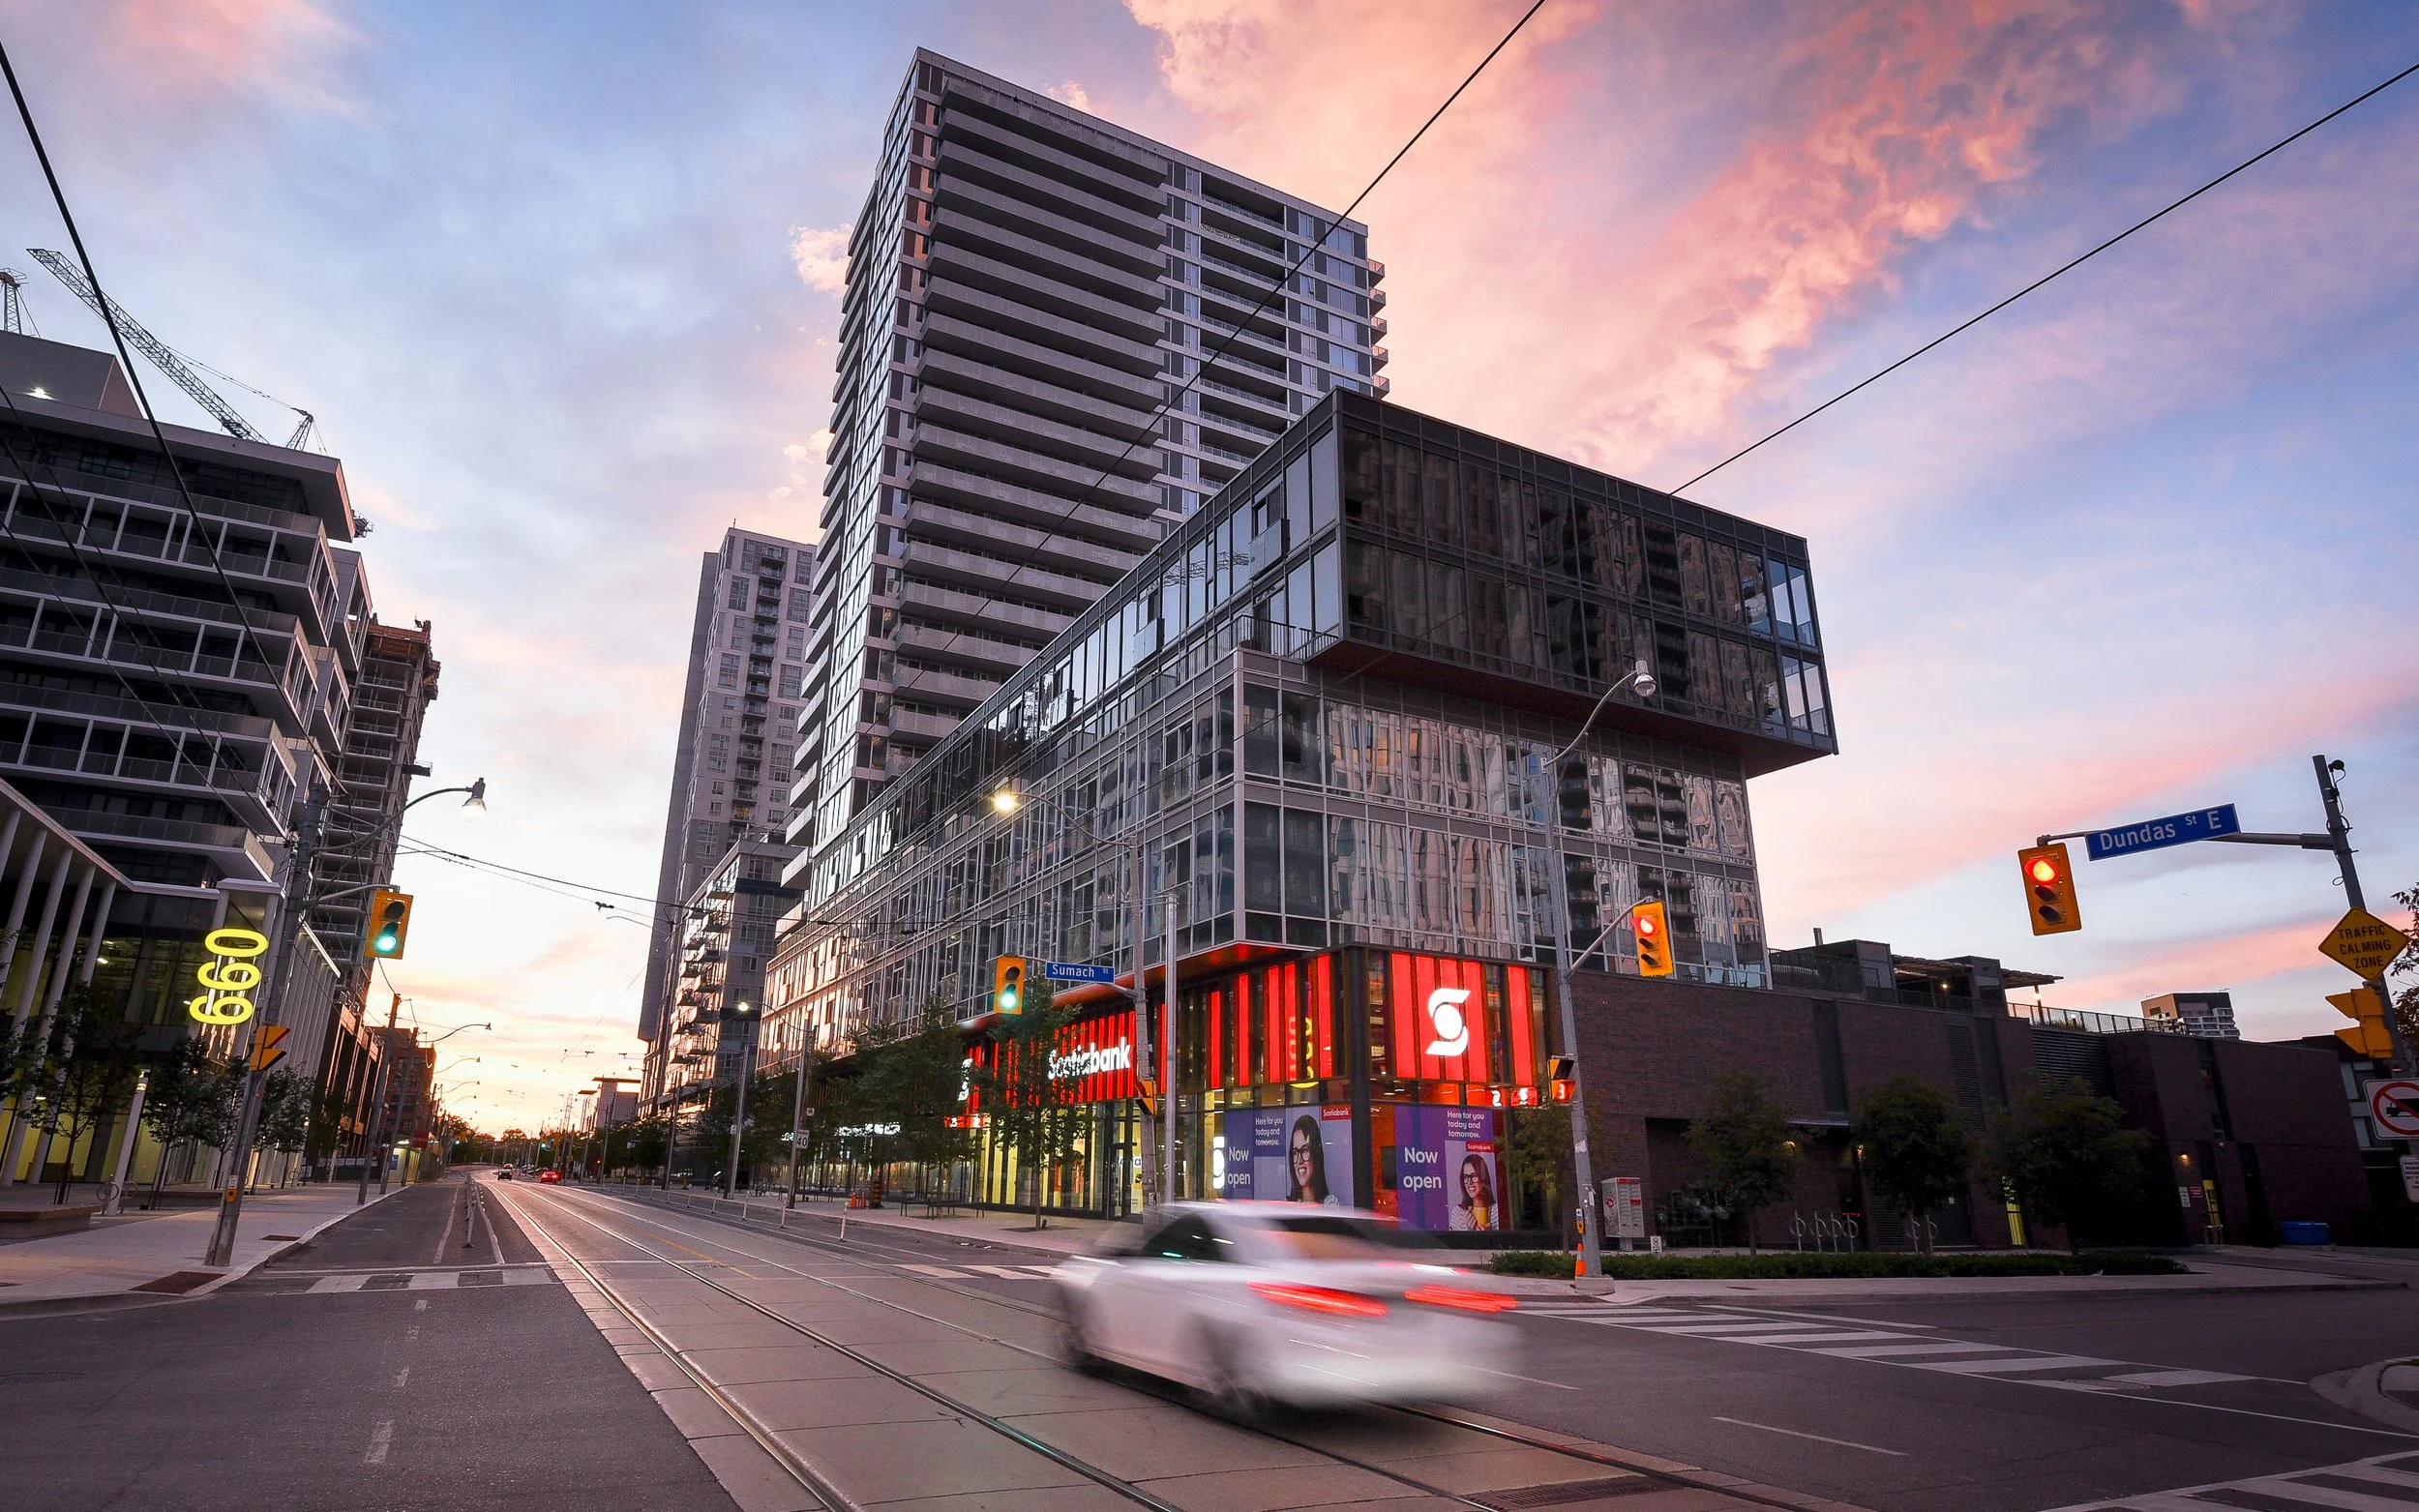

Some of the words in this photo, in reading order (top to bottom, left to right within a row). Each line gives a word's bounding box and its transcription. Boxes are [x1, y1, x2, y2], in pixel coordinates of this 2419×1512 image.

[2100, 823, 2176, 850] Dundas
[2185, 815, 2197, 826] St
[2207, 810, 2222, 829] E
[2338, 924, 2386, 940] TRAFFIC
[2340, 939, 2392, 955] CALMING
[2353, 956, 2384, 969] ZONE
[189, 928, 269, 1025] 660
[1052, 964, 1094, 978] Sumach
[1273, 1117, 1284, 1126] you
[1448, 1120, 1467, 1130] today
[1255, 1128, 1269, 1137] today
[1269, 1127, 1280, 1136] and
[1448, 1130, 1480, 1139] tomorrow.
[796, 1137, 807, 1147] 40
[1228, 1147, 1249, 1162] Now
[1404, 1147, 1438, 1164] Now
[1227, 1172, 1251, 1188] open
[1403, 1174, 1442, 1192] open
